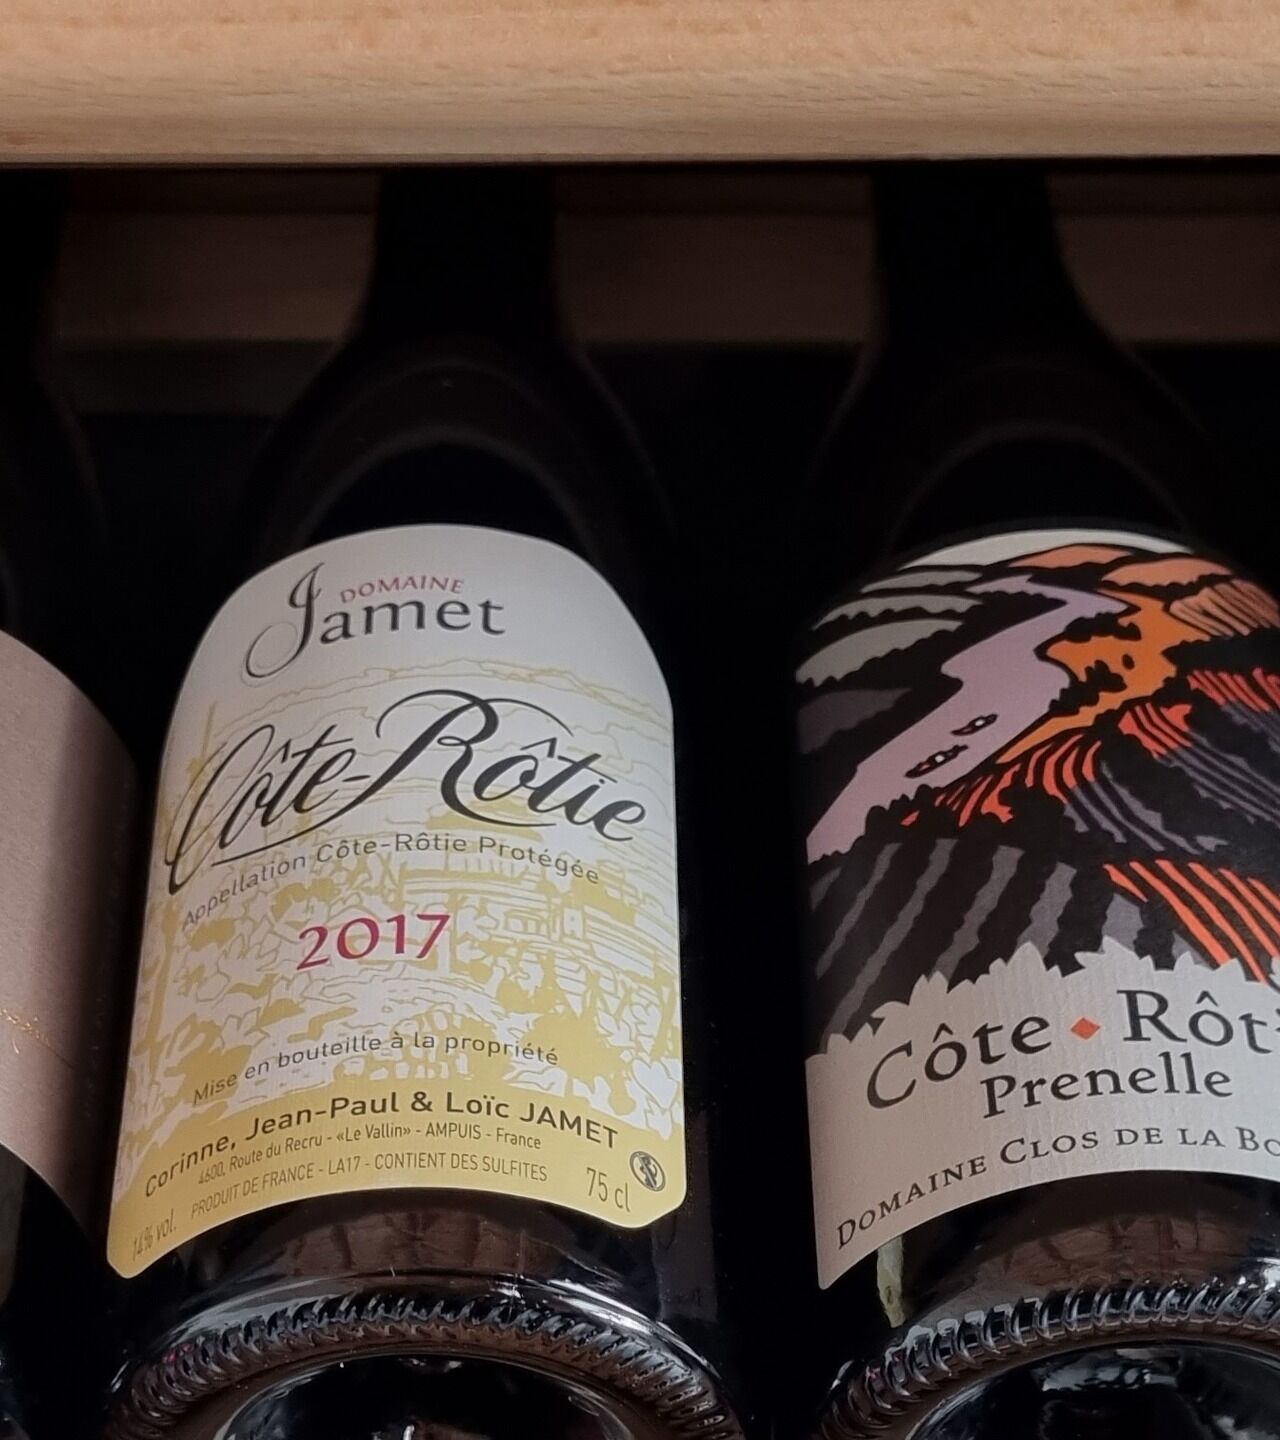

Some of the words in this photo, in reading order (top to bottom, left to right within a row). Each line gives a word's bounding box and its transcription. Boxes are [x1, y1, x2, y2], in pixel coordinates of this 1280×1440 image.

[240, 562, 507, 688] Jamet
[338, 574, 466, 605] DOMAINE
[164, 687, 649, 896] Côte-Rôtie
[182, 854, 307, 930] Appellation
[316, 832, 468, 863] Côte-Rôtie
[479, 836, 600, 886] Protégée
[297, 913, 452, 972] 2017
[192, 1070, 238, 1106] Mise
[244, 1060, 271, 1082] en
[277, 1033, 382, 1071] bouteille
[391, 1031, 405, 1051] à
[413, 1031, 436, 1050] la
[444, 1033, 560, 1067] propriété
[865, 1012, 1053, 1111] Côte
[980, 1050, 1234, 1120] Prenelle
[144, 1133, 237, 1198] Corinne,
[245, 1092, 400, 1145] Jean-Paul
[410, 1091, 434, 1113] &
[446, 1090, 510, 1119] Loïc
[519, 1102, 619, 1150] JAMET
[229, 1149, 263, 1172] Route
[266, 1144, 282, 1160] du
[284, 1134, 323, 1155] Recru
[424, 1122, 482, 1141] AMPUIS
[495, 1127, 543, 1150] France
[190, 1184, 240, 1220] PRODUIT
[242, 1176, 260, 1198] DE
[262, 1162, 316, 1190] FRANCE
[327, 1154, 361, 1177] LA17
[373, 1151, 447, 1172] CONTIENT
[450, 1152, 479, 1172] DES
[481, 1155, 549, 1183] SULFITES
[586, 1166, 609, 1203] 75
[614, 1182, 632, 1213] cl
[835, 1155, 988, 1251] DOMAINE
[998, 1129, 1100, 1166] CLOS
[1115, 1126, 1164, 1147] DE
[1179, 1127, 1225, 1149] LA
